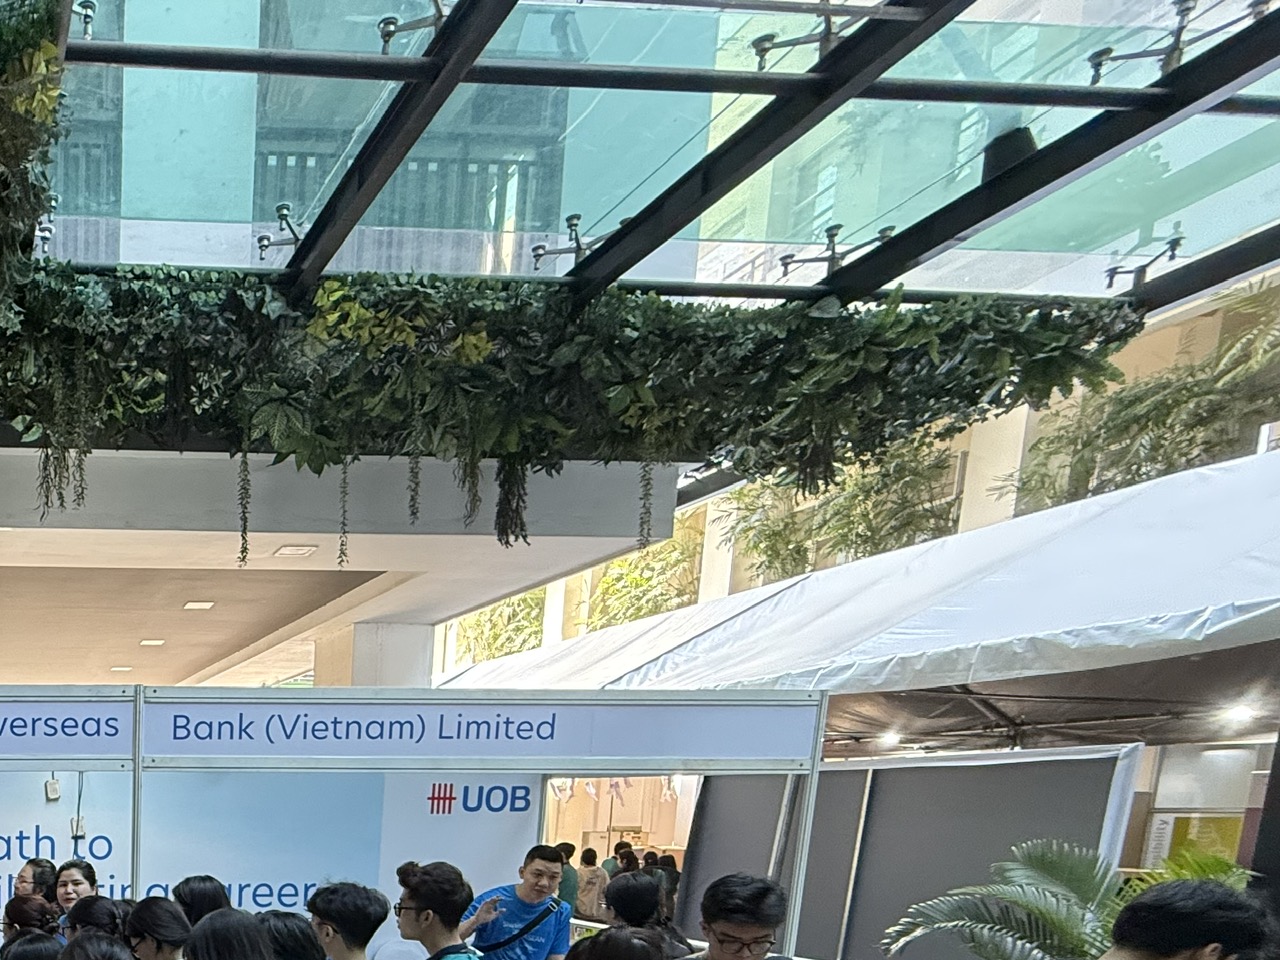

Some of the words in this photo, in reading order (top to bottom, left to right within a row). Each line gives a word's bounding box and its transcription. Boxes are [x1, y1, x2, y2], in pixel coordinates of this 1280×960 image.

[171, 712, 255, 741] Bank
[264, 713, 426, 744] (Vietnam)
[437, 712, 557, 741] Limited
[461, 785, 532, 813] UOB
[226, 882, 318, 908] reer
